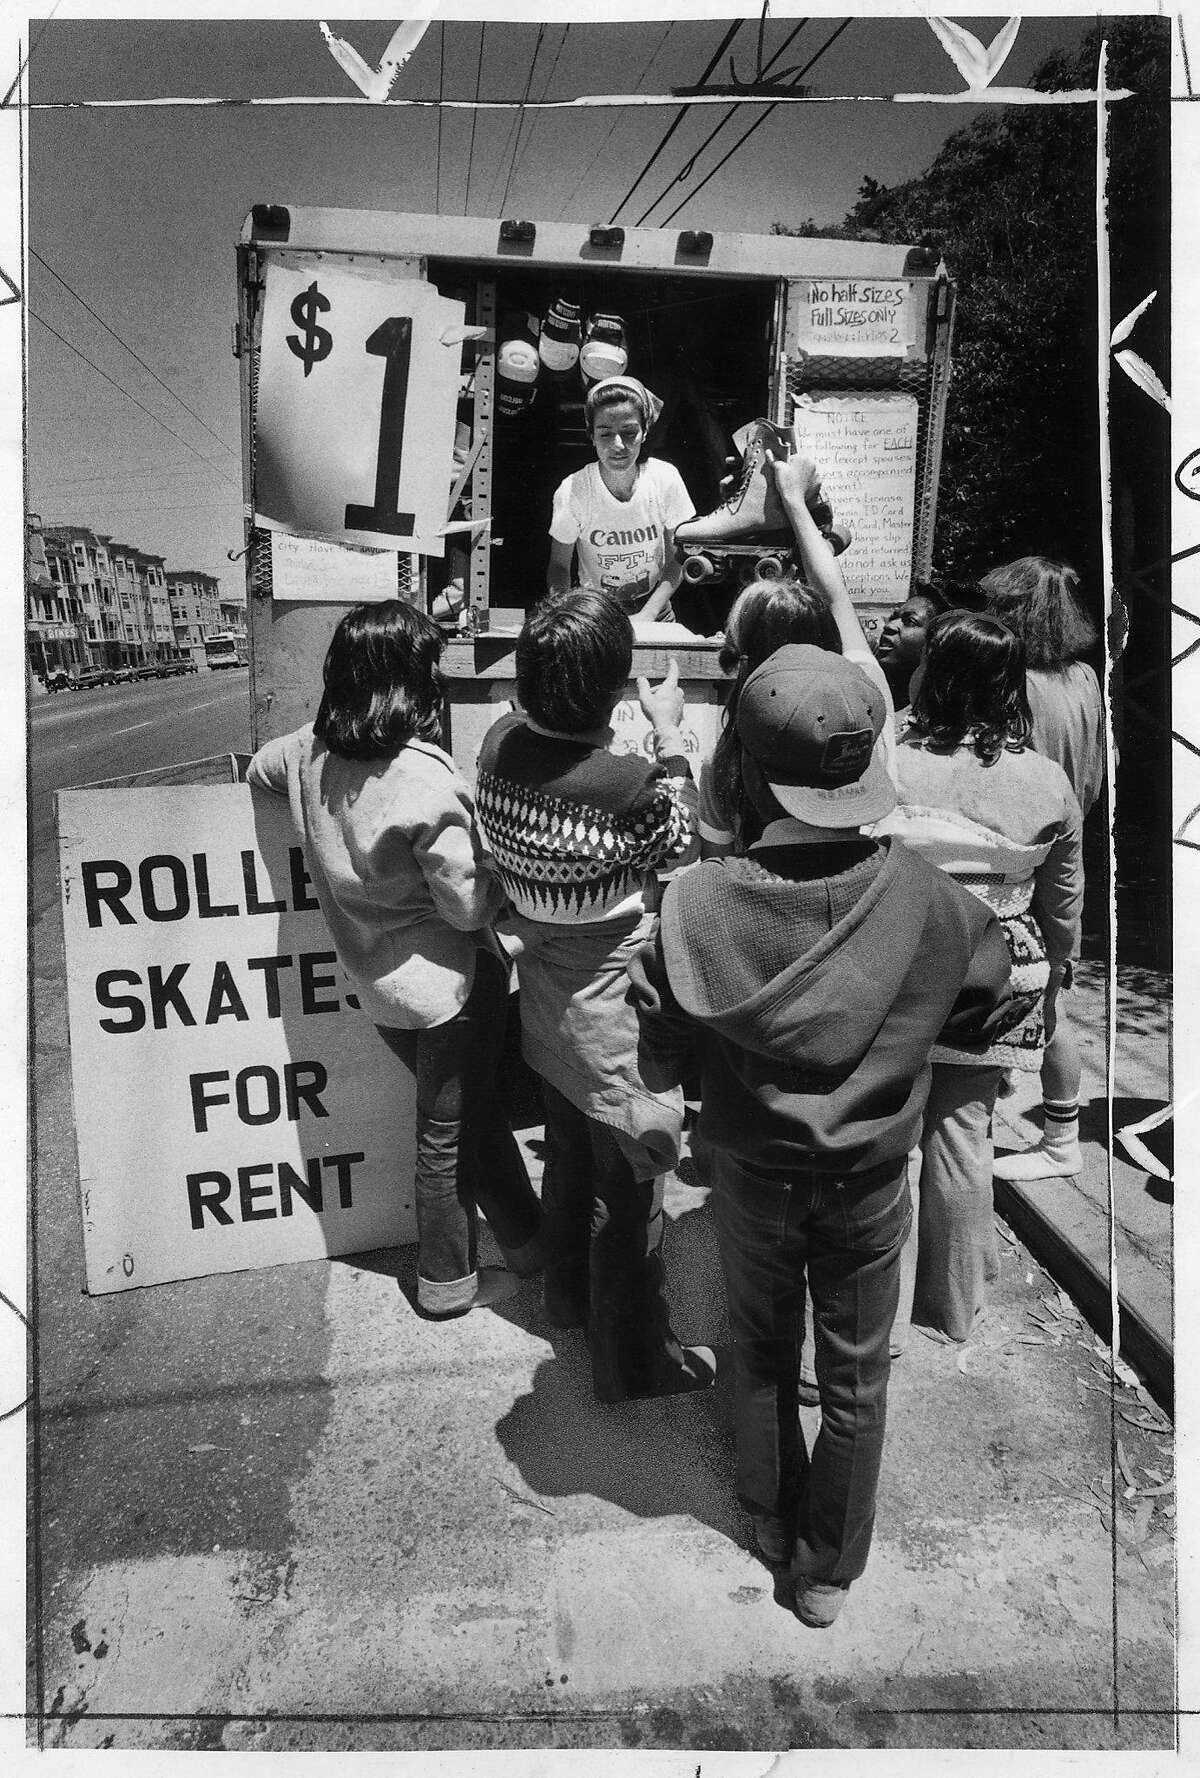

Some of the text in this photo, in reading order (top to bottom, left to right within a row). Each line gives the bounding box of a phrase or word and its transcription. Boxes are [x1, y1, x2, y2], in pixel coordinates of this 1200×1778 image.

[808, 282, 828, 304] No
[831, 283, 858, 303] half
[811, 307, 832, 327] Full
[844, 426, 870, 437] have
[872, 427, 892, 437] one
[895, 423, 910, 434] of
[864, 438, 880, 450] for
[884, 437, 912, 450] EACH
[881, 504, 904, 516] Card
[590, 525, 658, 547] Canon
[879, 557, 896, 568] ask
[900, 559, 912, 568] us
[894, 569, 910, 581] We
[81, 846, 321, 929] ROLLE
[95, 950, 361, 1035] SKATE
[189, 1060, 330, 1133] FOR
[186, 1151, 365, 1230] RENT
